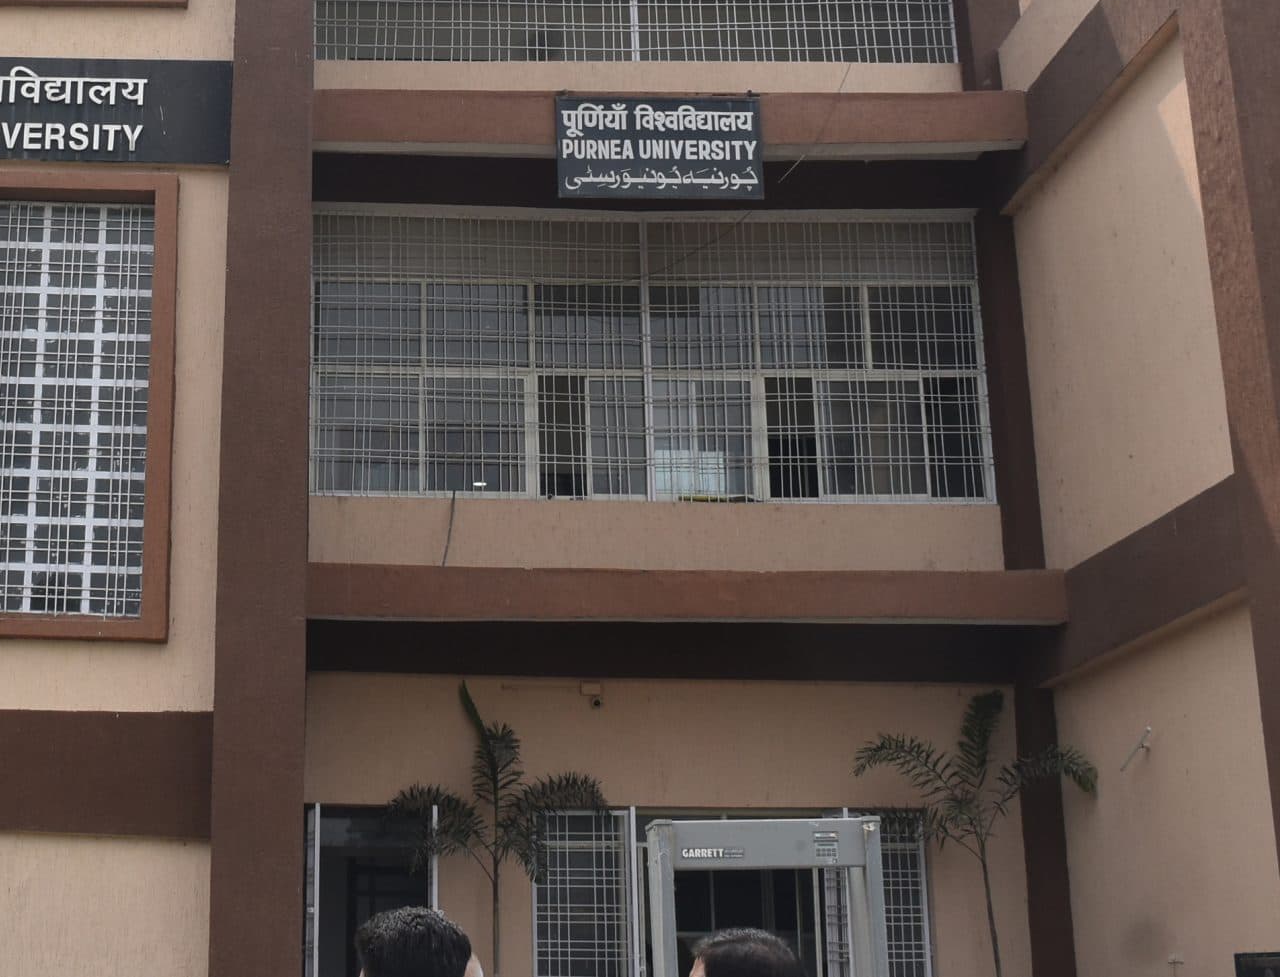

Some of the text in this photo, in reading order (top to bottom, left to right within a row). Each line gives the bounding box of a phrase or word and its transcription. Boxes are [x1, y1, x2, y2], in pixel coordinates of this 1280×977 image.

[561, 102, 754, 137] पूर्णियाँ विश्वविद्यालय
[562, 139, 757, 160] PURNEA UNIVERSITY
[682, 848, 724, 858] GARRETT
